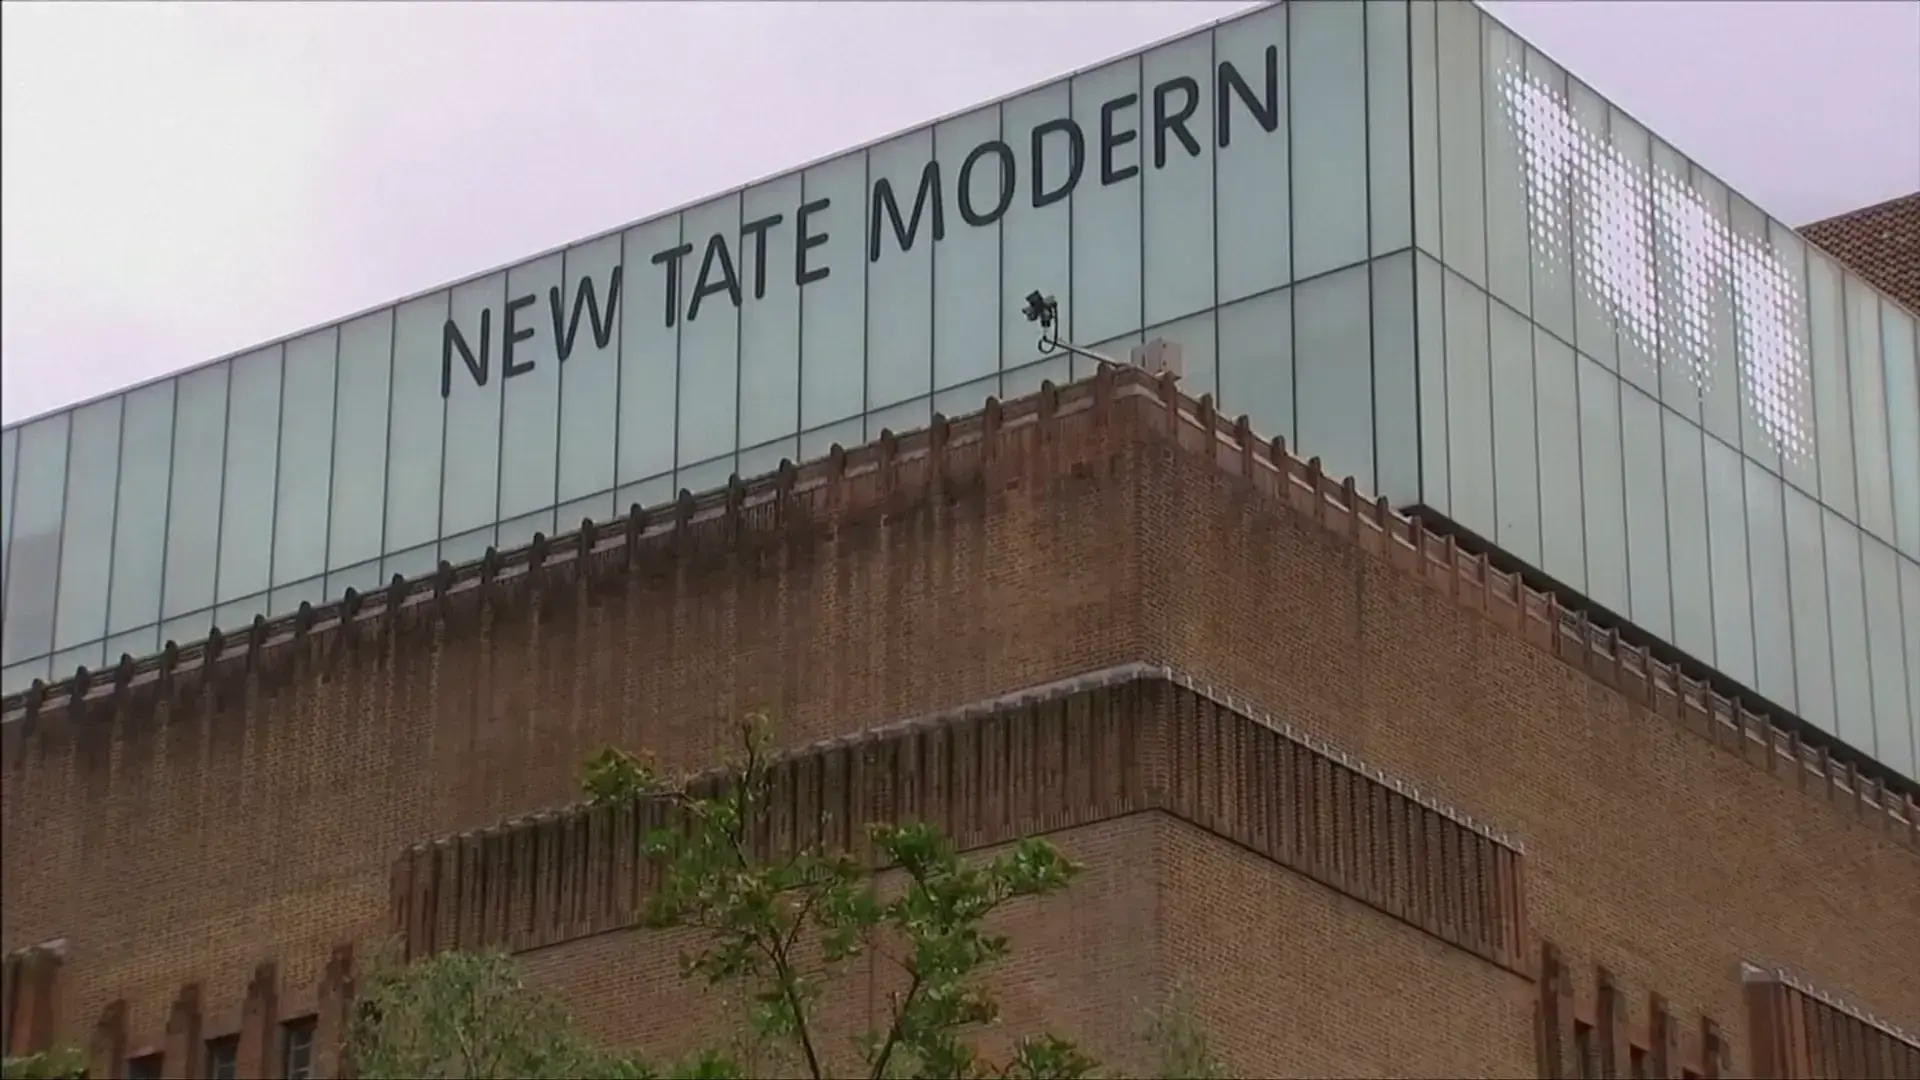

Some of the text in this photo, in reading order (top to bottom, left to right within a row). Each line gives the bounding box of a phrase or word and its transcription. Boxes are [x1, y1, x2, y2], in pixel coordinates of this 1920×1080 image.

[442, 45, 1279, 399] NEW TATE MODERN
